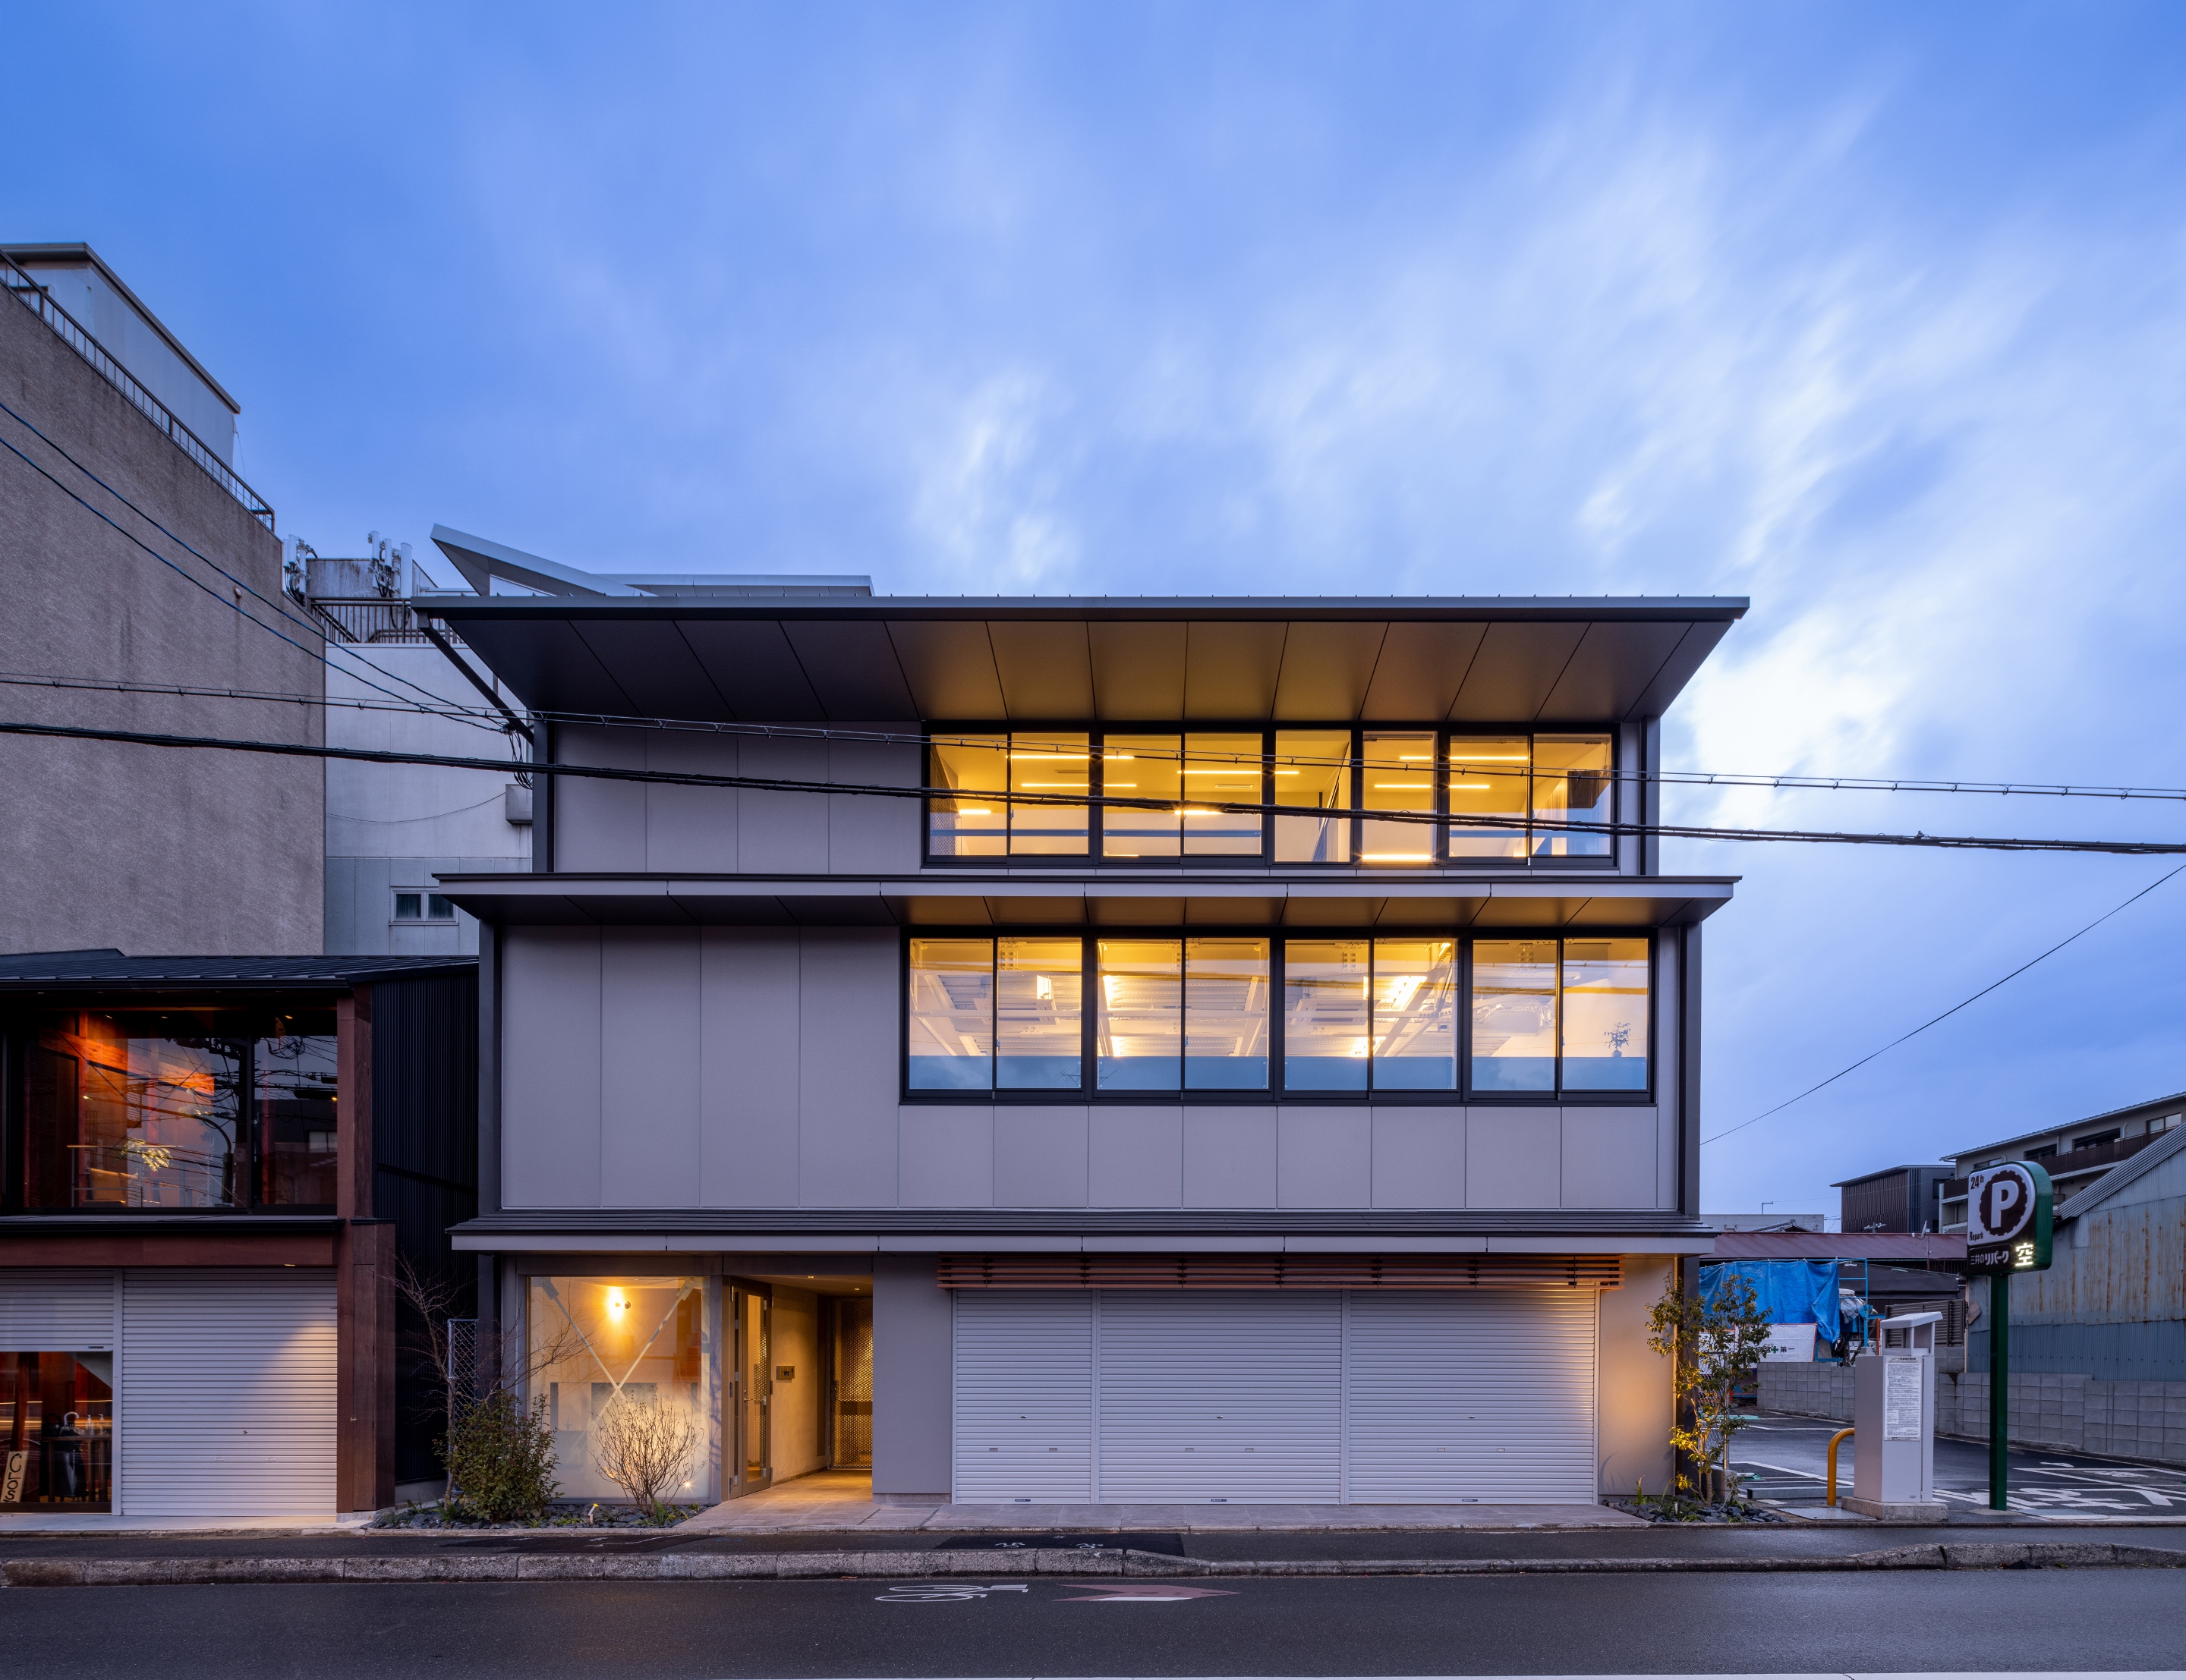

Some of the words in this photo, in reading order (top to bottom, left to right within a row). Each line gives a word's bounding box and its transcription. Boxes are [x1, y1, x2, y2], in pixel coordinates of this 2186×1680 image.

[1970, 1175, 1984, 1190] 24h
[1990, 1180, 2019, 1229] P
[1969, 1231, 1984, 1241] Repark
[1970, 1251, 2009, 1266] 三井のリパーク
[2014, 1242, 2033, 1266] 空
